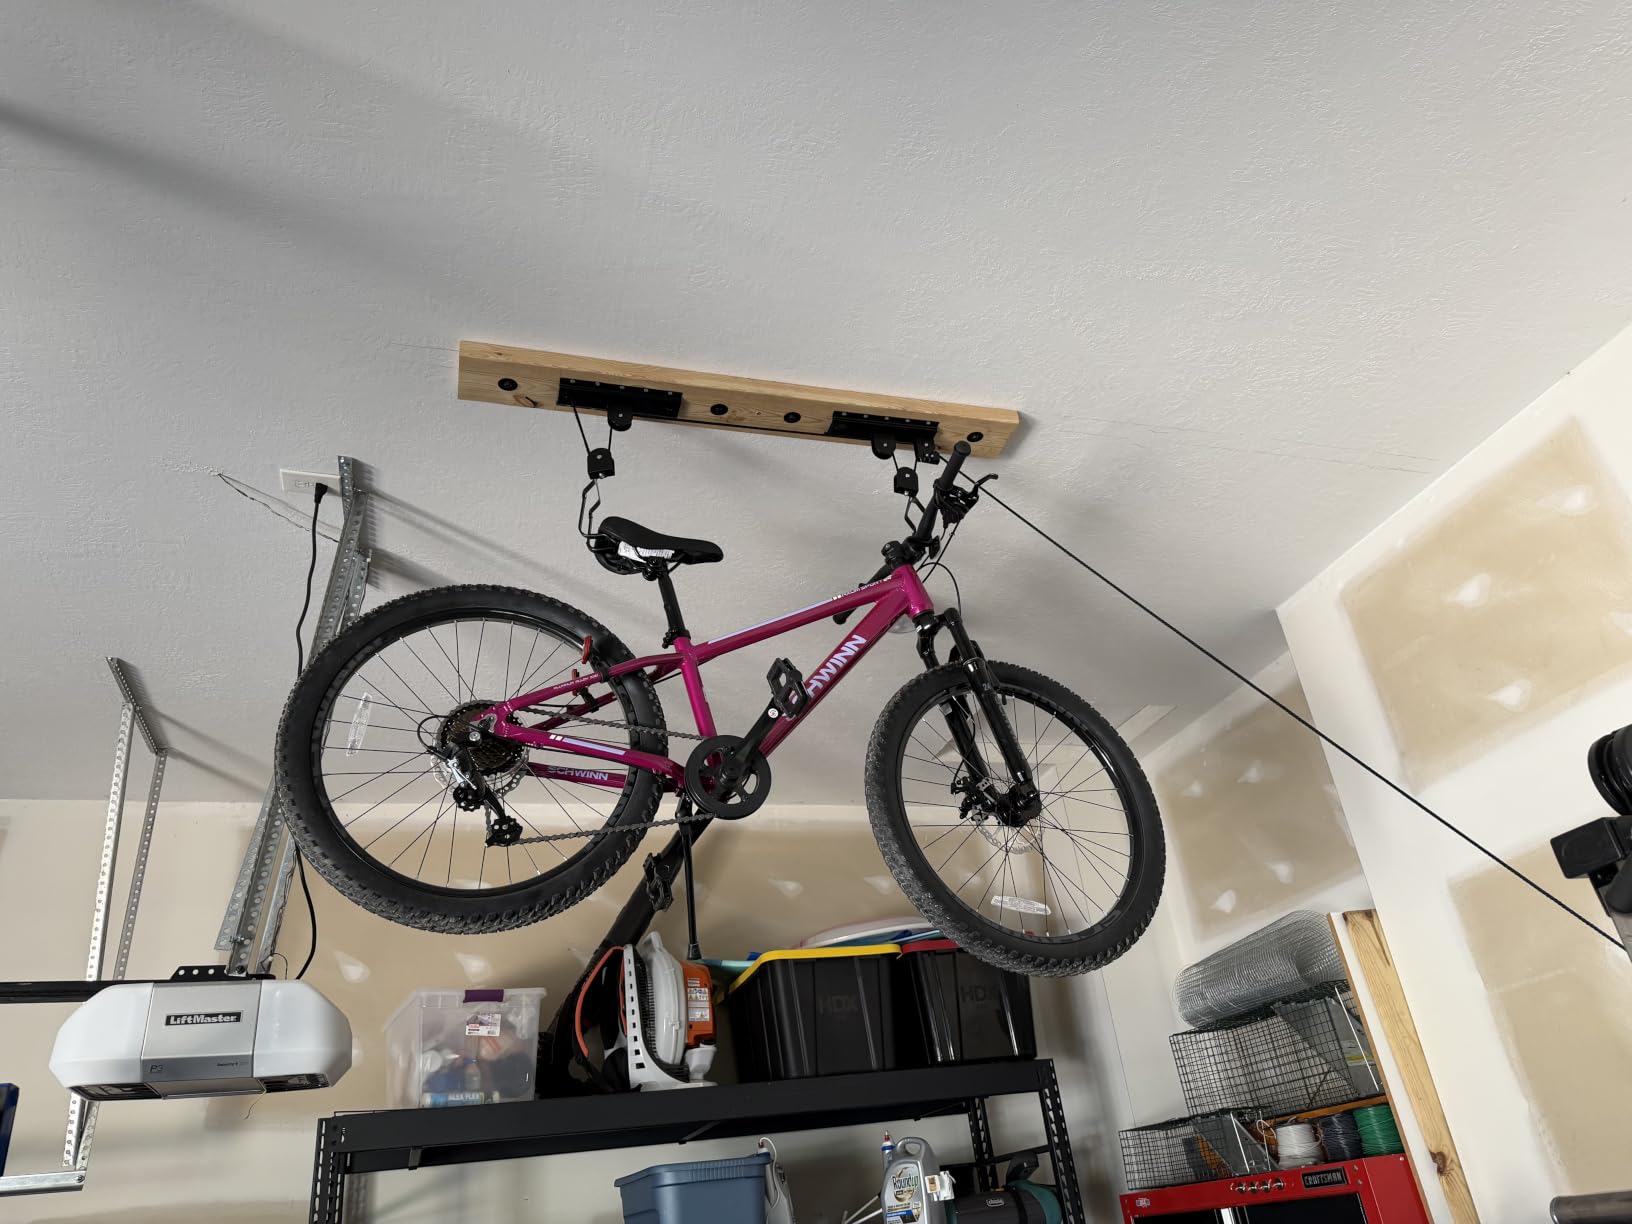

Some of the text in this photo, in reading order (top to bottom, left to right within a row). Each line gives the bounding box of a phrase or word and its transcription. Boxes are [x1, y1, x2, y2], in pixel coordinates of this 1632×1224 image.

[548, 766, 608, 781] SCHWINN
[169, 1014, 237, 1025] LiftMaster
[1304, 1171, 1343, 1186] CRAFTSMAN
